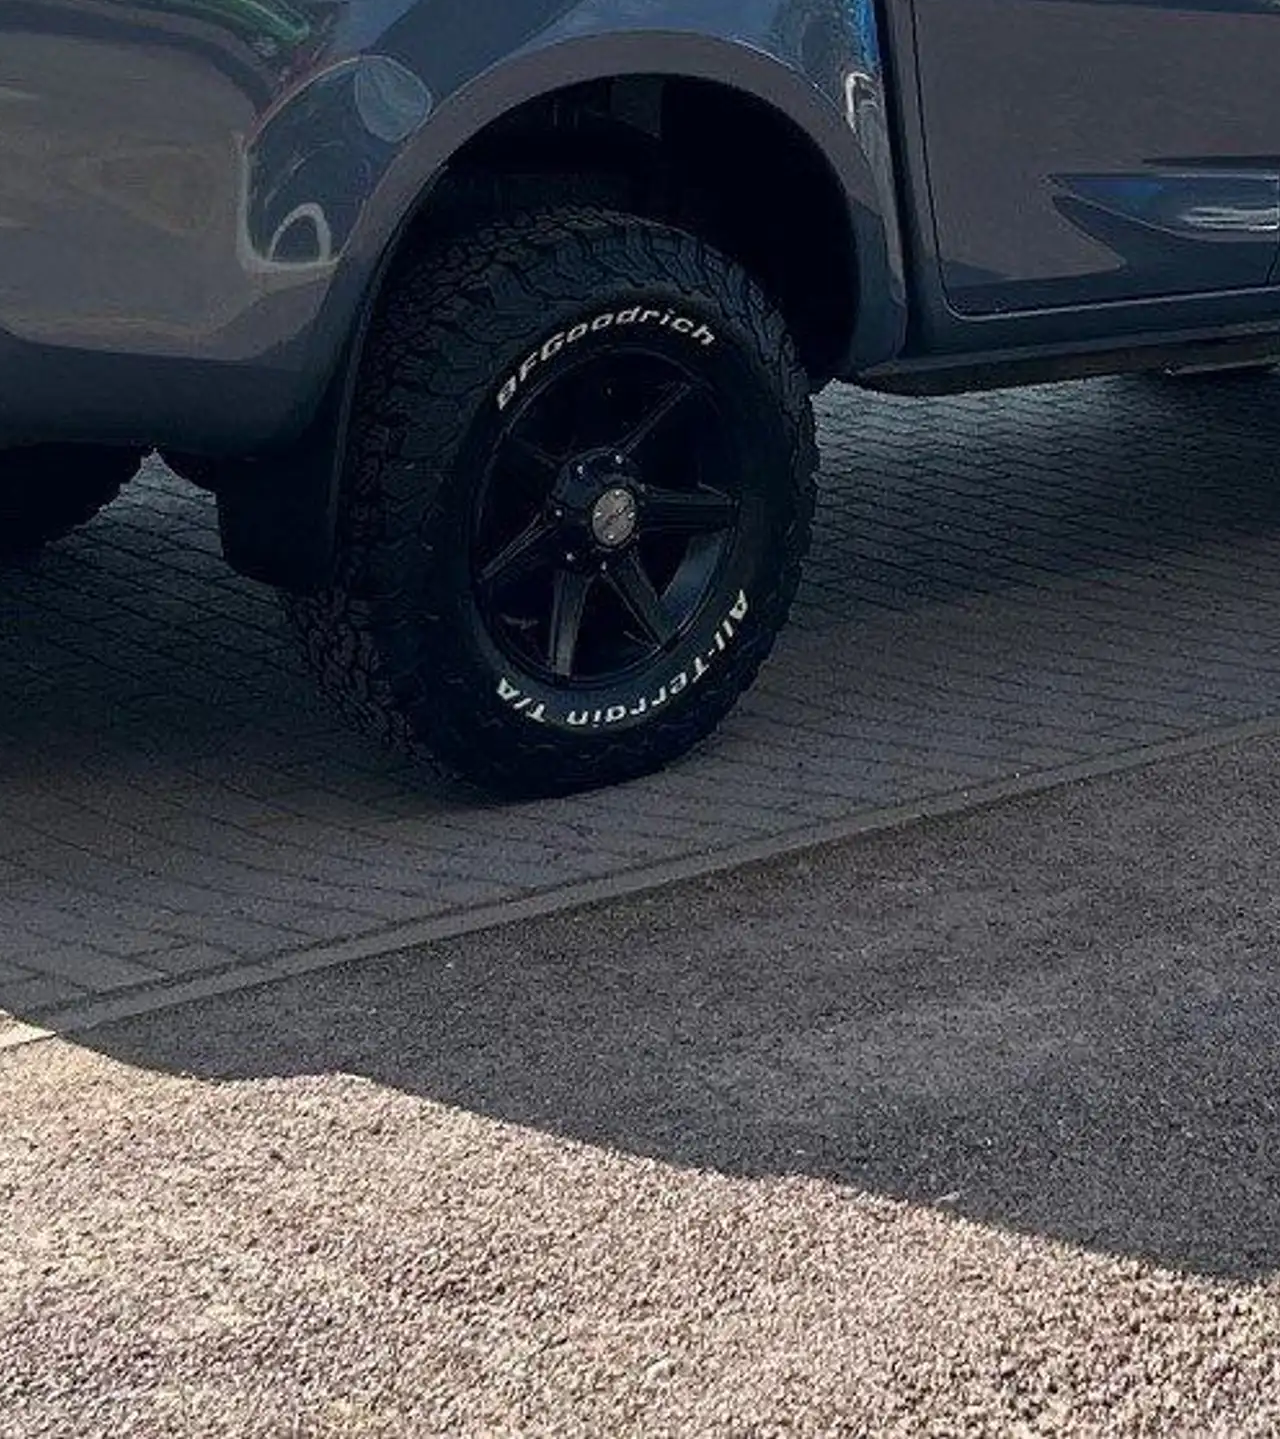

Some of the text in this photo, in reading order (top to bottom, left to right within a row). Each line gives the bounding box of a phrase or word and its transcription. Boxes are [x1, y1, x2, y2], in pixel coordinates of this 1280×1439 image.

[496, 306, 716, 411] BFGoodrich
[496, 589, 749, 728] All-Terrain T/A
